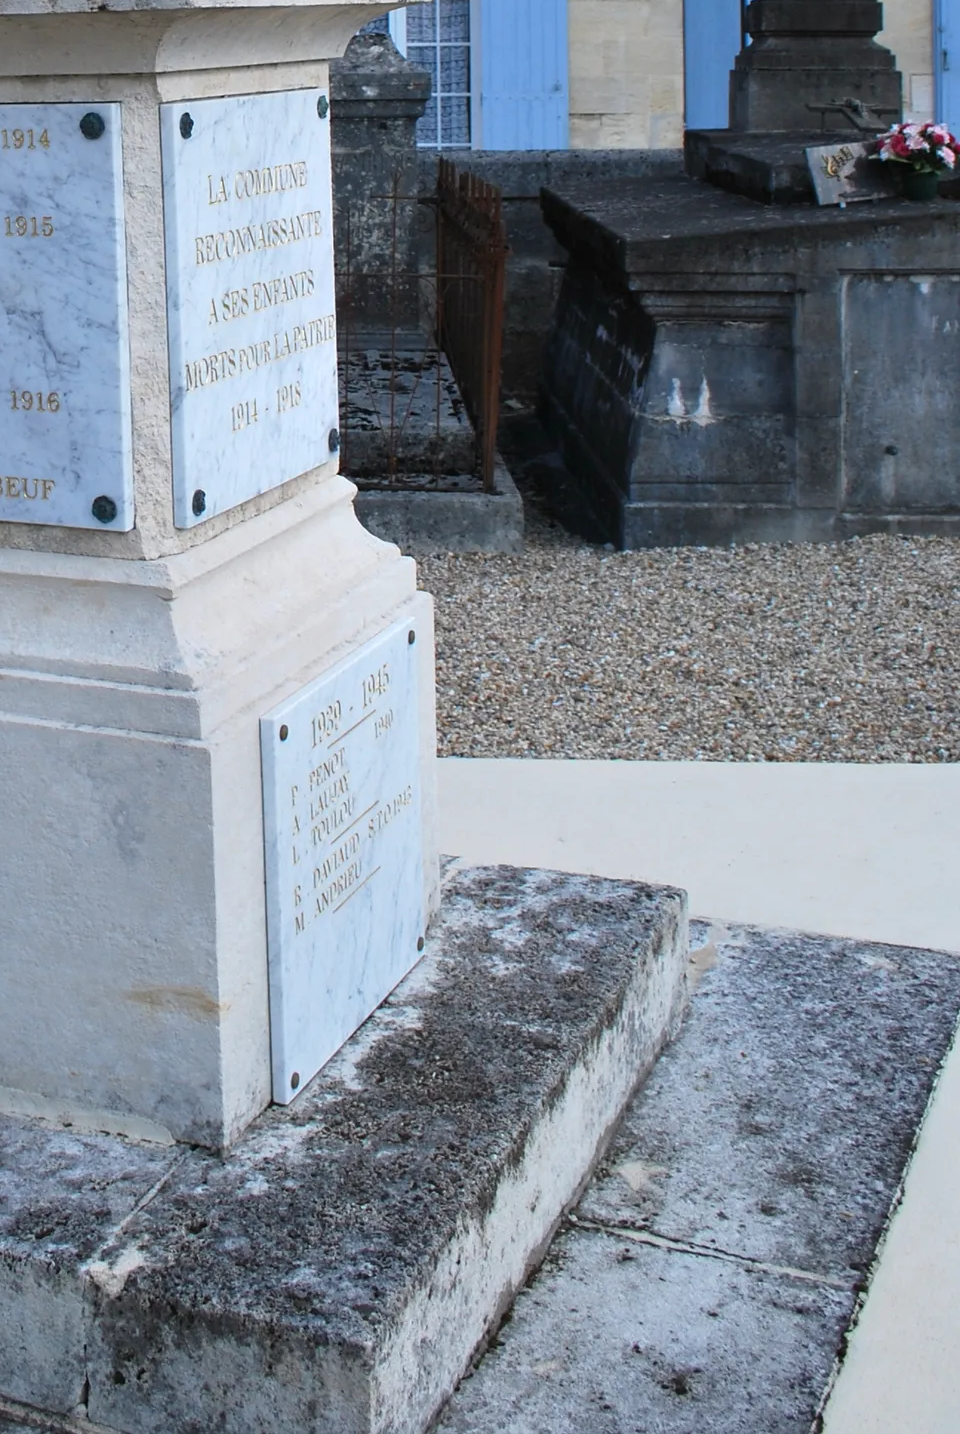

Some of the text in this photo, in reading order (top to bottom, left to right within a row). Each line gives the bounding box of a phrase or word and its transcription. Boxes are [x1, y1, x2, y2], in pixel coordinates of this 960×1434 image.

[1, 129, 50, 149] 1914
[208, 161, 308, 205] LA COMMUNE
[4, 216, 54, 237] 1915
[195, 211, 322, 265] RECONNAISSANTE
[208, 269, 315, 325] A SES ENFANTS
[184, 314, 335, 392] MORTS POUR LA PATRIE
[9, 390, 60, 412] 1916
[231, 398, 258, 431] 1914
[276, 381, 302, 413] 1918
[311, 699, 342, 748] 1939
[362, 662, 390, 708] 1945
[374, 709, 394, 739] 1940
[313, 832, 361, 888] DAVIAUD
[314, 858, 362, 918] ANDRIEU
